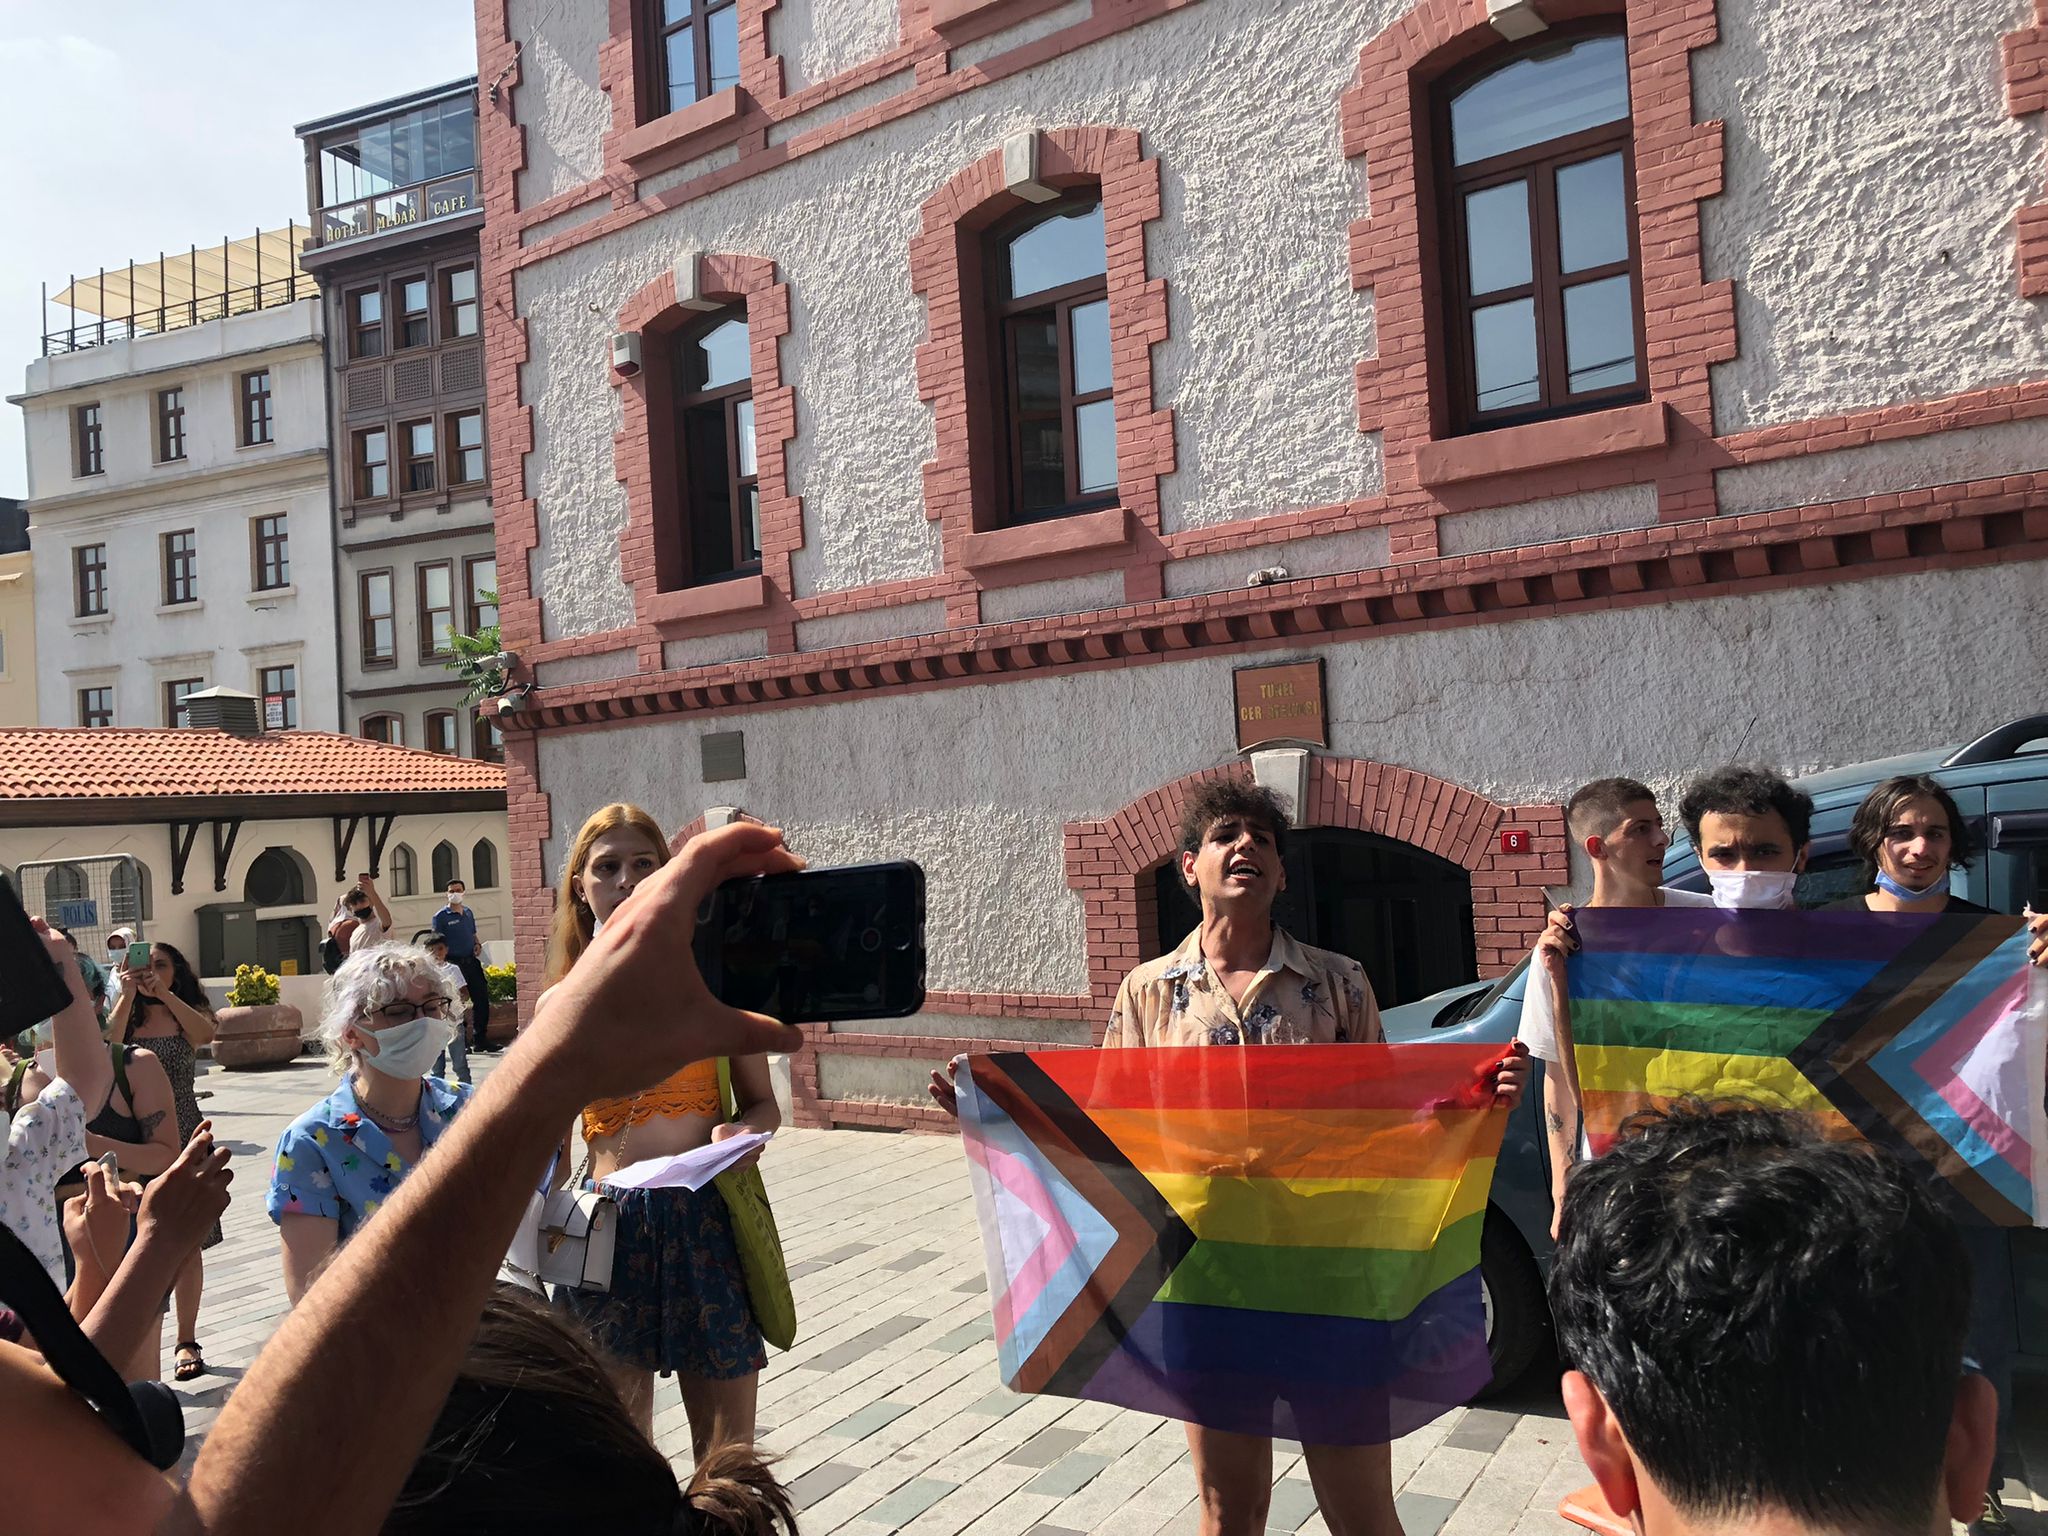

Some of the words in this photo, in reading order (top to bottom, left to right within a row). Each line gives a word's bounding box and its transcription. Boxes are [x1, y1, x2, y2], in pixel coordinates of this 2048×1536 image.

[326, 223, 366, 242] HOTEL
[434, 195, 466, 214] CAFE
[1240, 705, 1262, 721] CER
[1510, 834, 1518, 847] 6
